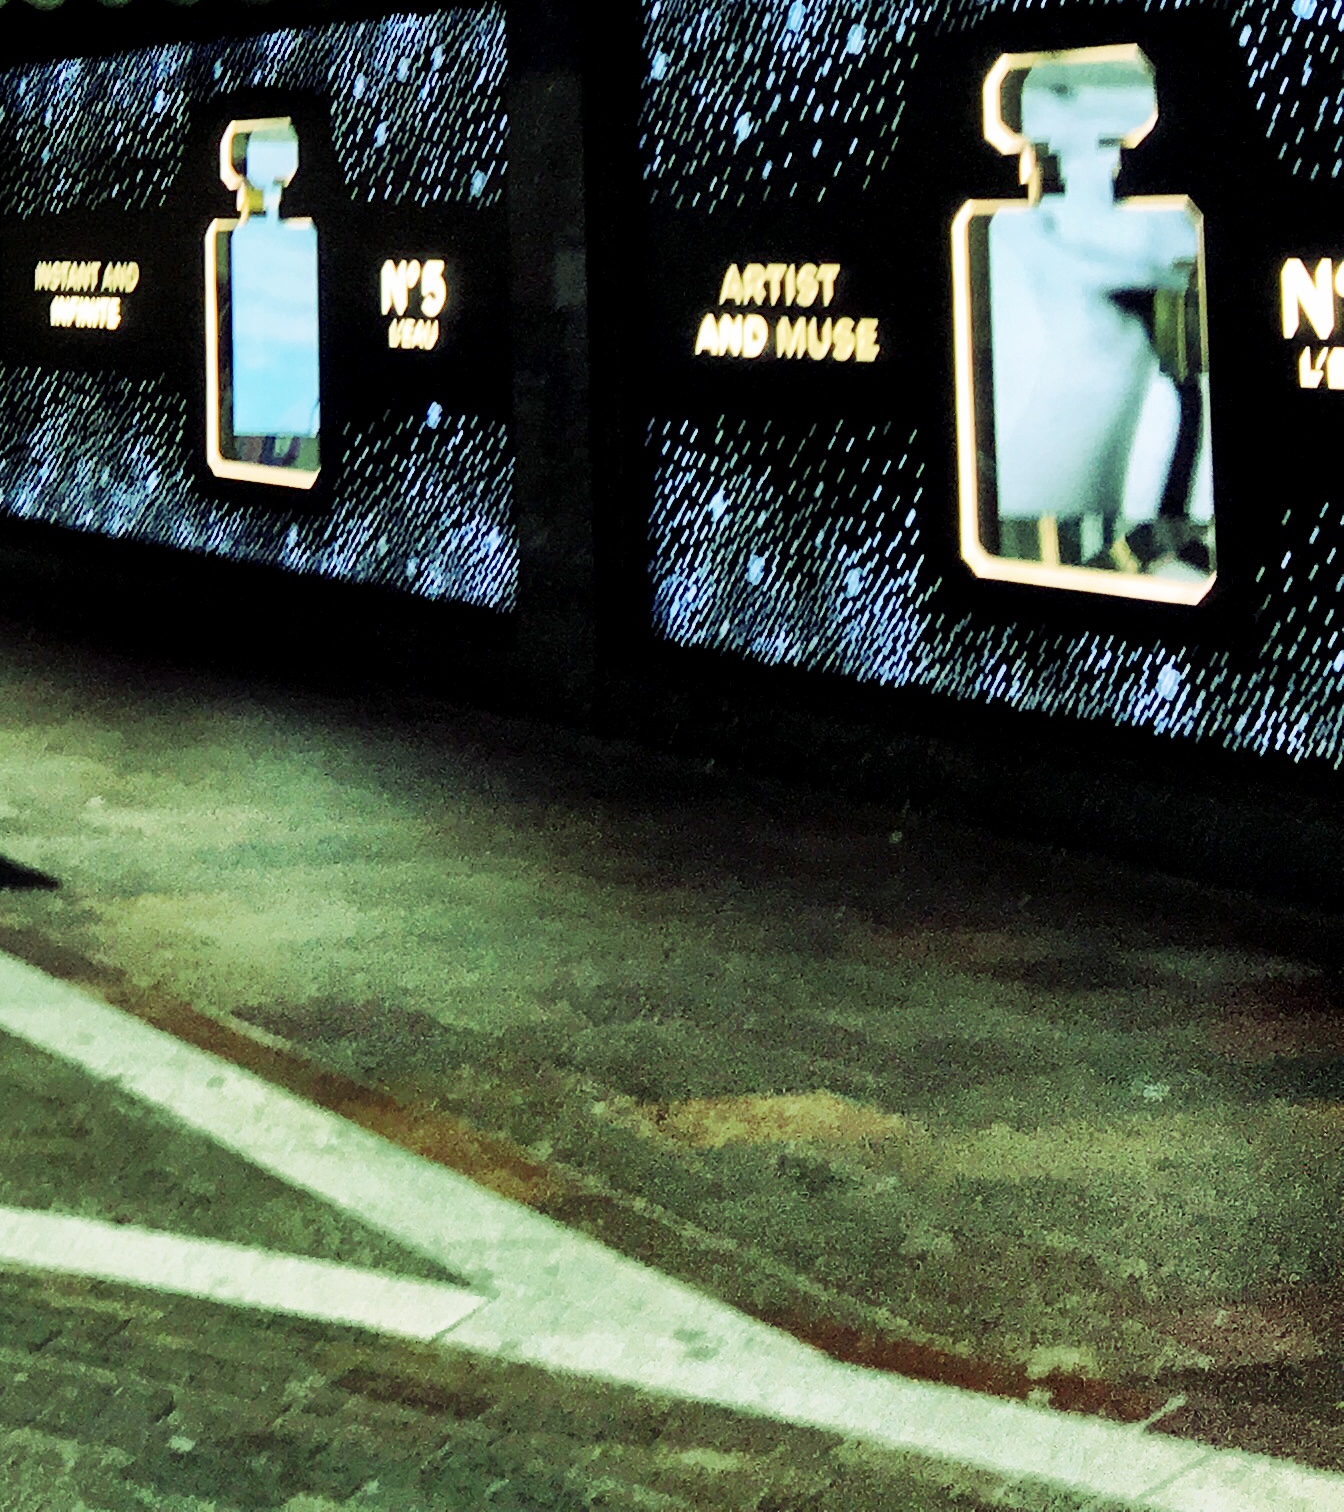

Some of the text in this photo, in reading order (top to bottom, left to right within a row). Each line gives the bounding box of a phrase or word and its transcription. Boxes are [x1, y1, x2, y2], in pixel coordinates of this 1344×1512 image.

[34, 260, 140, 294] INSTANT AND
[718, 262, 841, 308] ARTIST
[49, 294, 123, 331] INFINITE
[694, 312, 881, 363] AND MUSE
